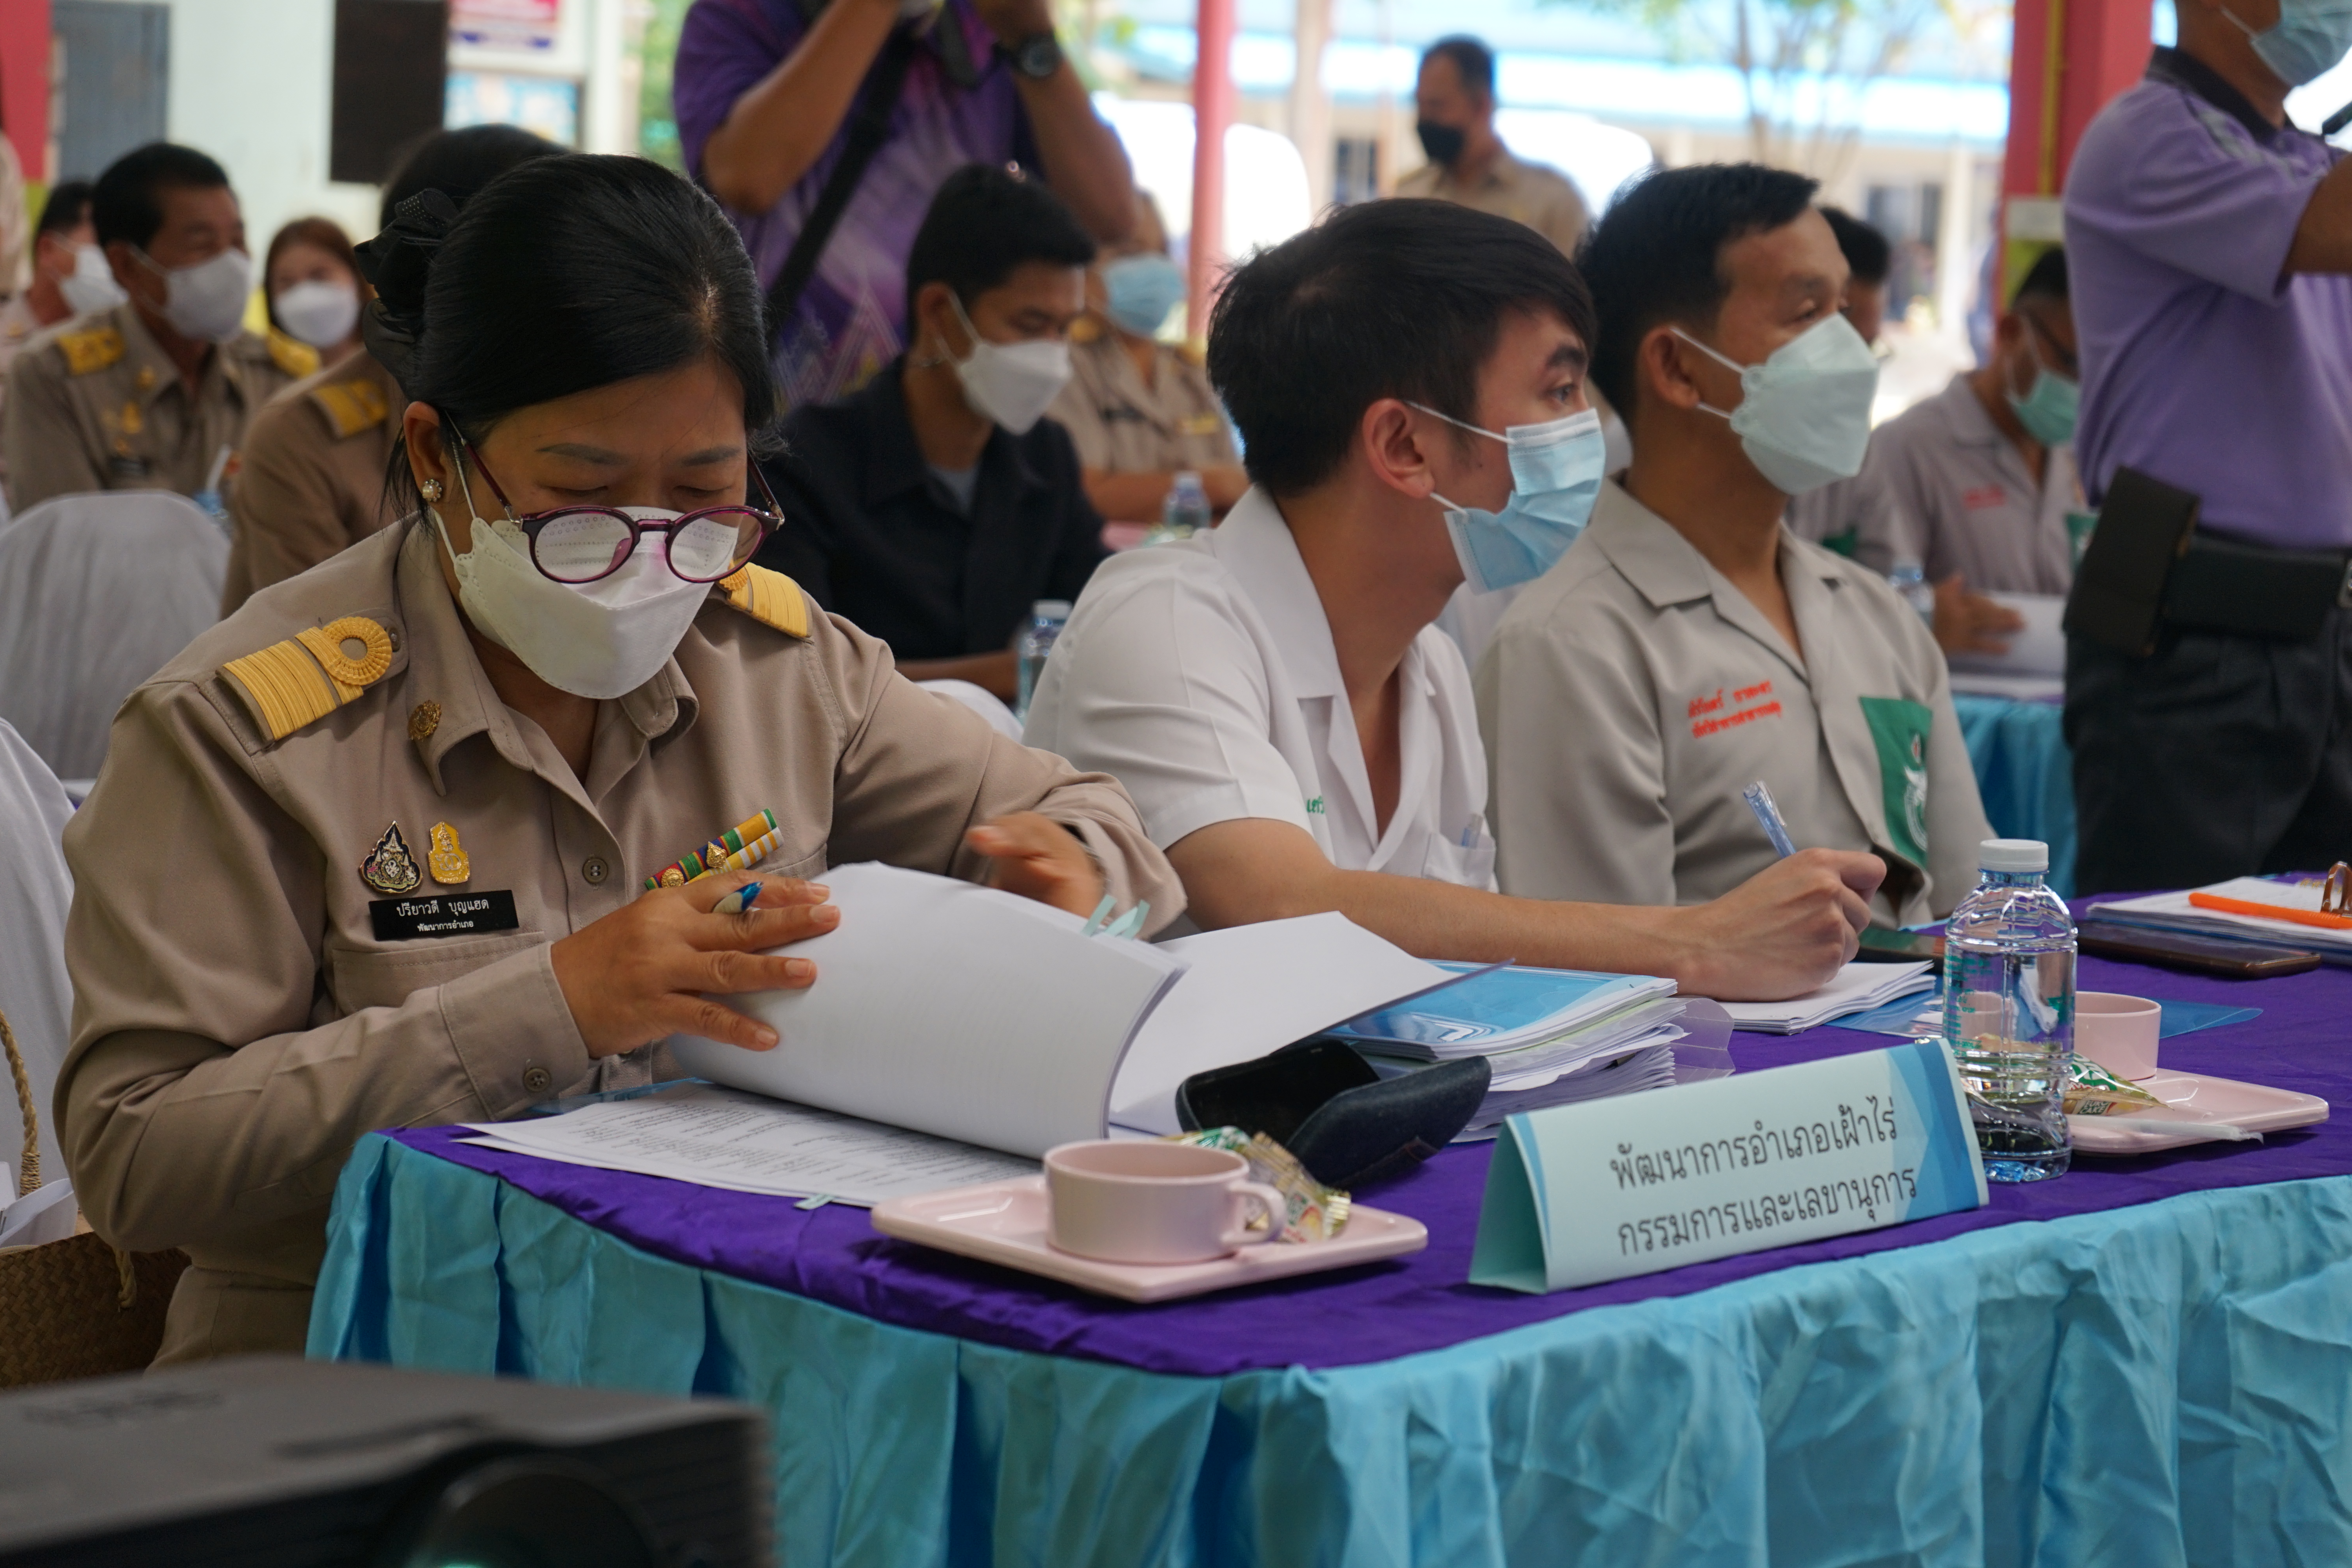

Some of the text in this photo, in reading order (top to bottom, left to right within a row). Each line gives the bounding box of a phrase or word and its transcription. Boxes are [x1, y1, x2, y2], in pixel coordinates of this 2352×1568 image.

[396, 899, 489, 916] ปรียาวดี บุญแฮด
[417, 920, 474, 931] พัฒนาการอำเภอ
[1610, 1095, 1897, 1189] พัฒนาการอำเภอเฝ้าไร่
[1618, 1168, 1917, 1256] กรรมการและเลขานุการ
